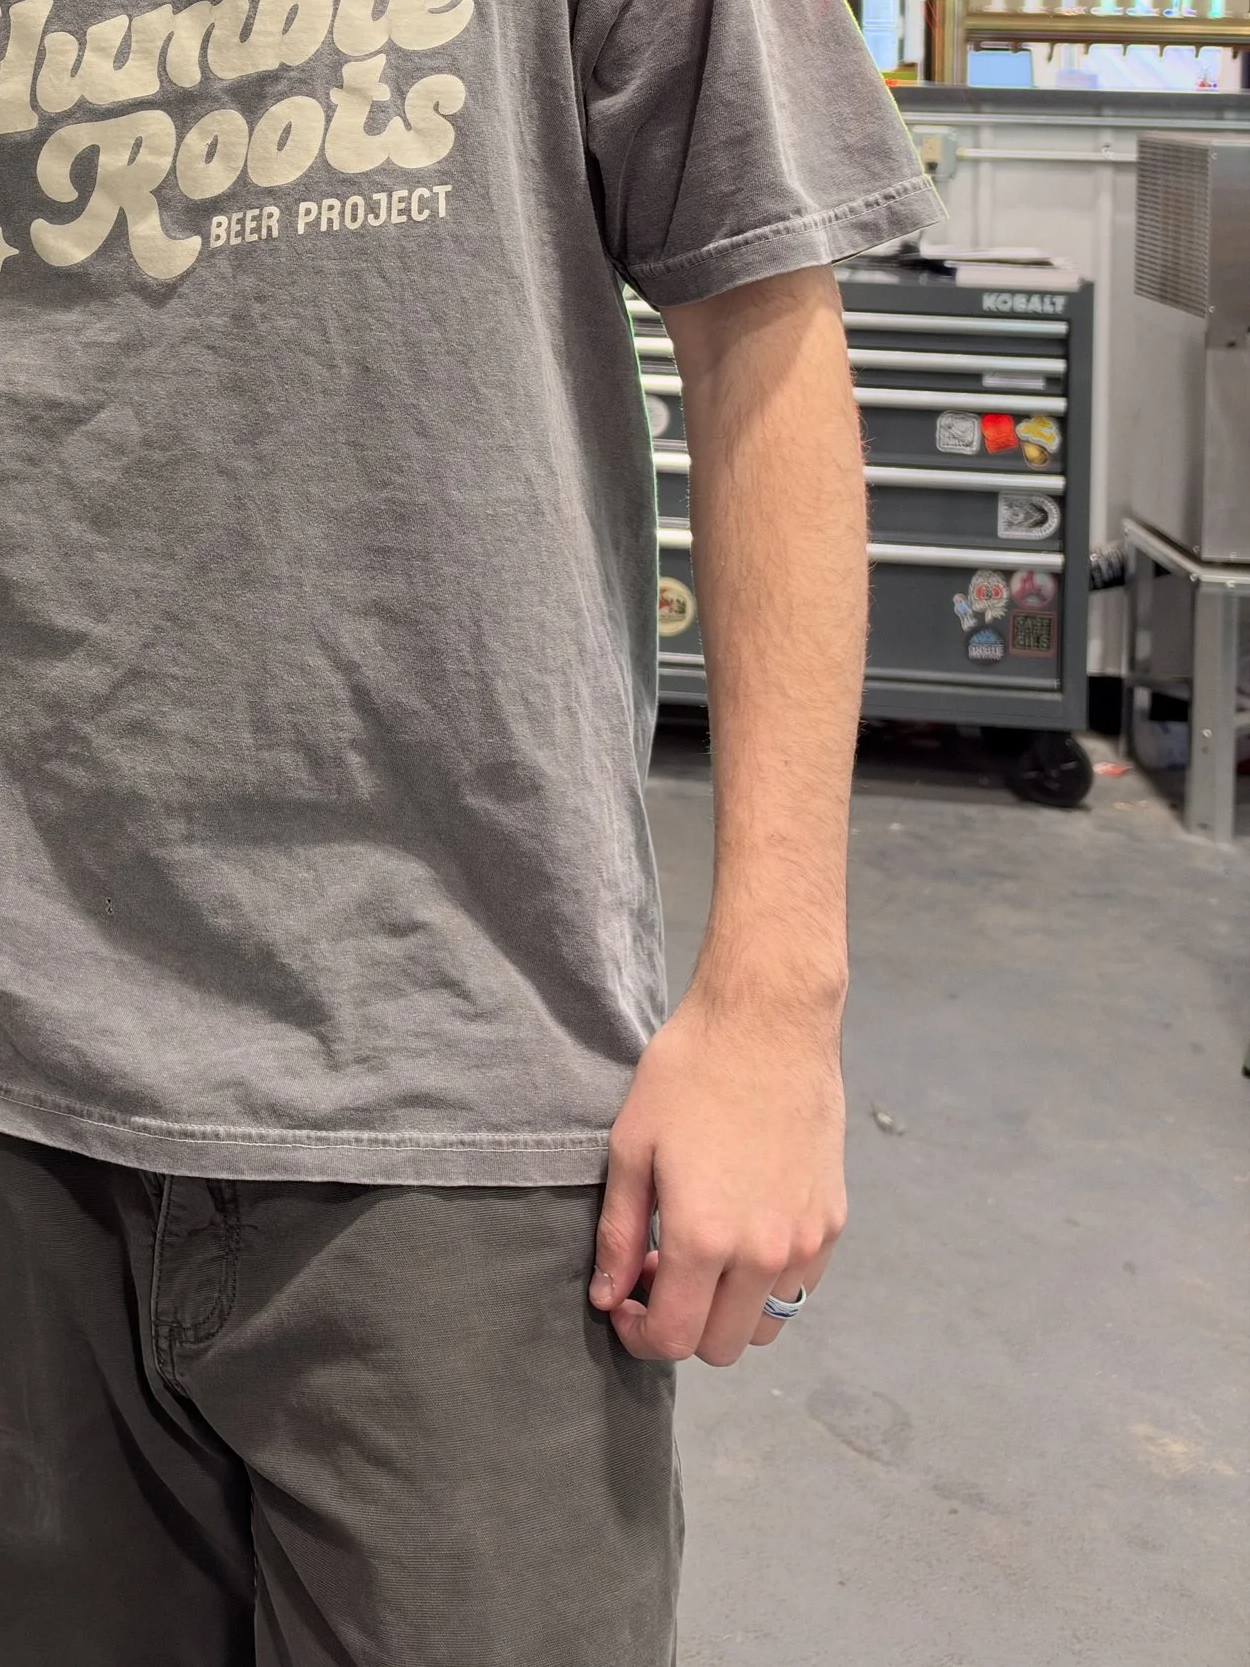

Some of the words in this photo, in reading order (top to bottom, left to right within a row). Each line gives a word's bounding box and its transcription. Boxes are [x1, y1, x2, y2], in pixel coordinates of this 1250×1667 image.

[30, 53, 467, 280] Roots
[210, 206, 280, 248] BEER
[298, 184, 453, 234] PROJECT
[982, 292, 1067, 314] KOBALT
